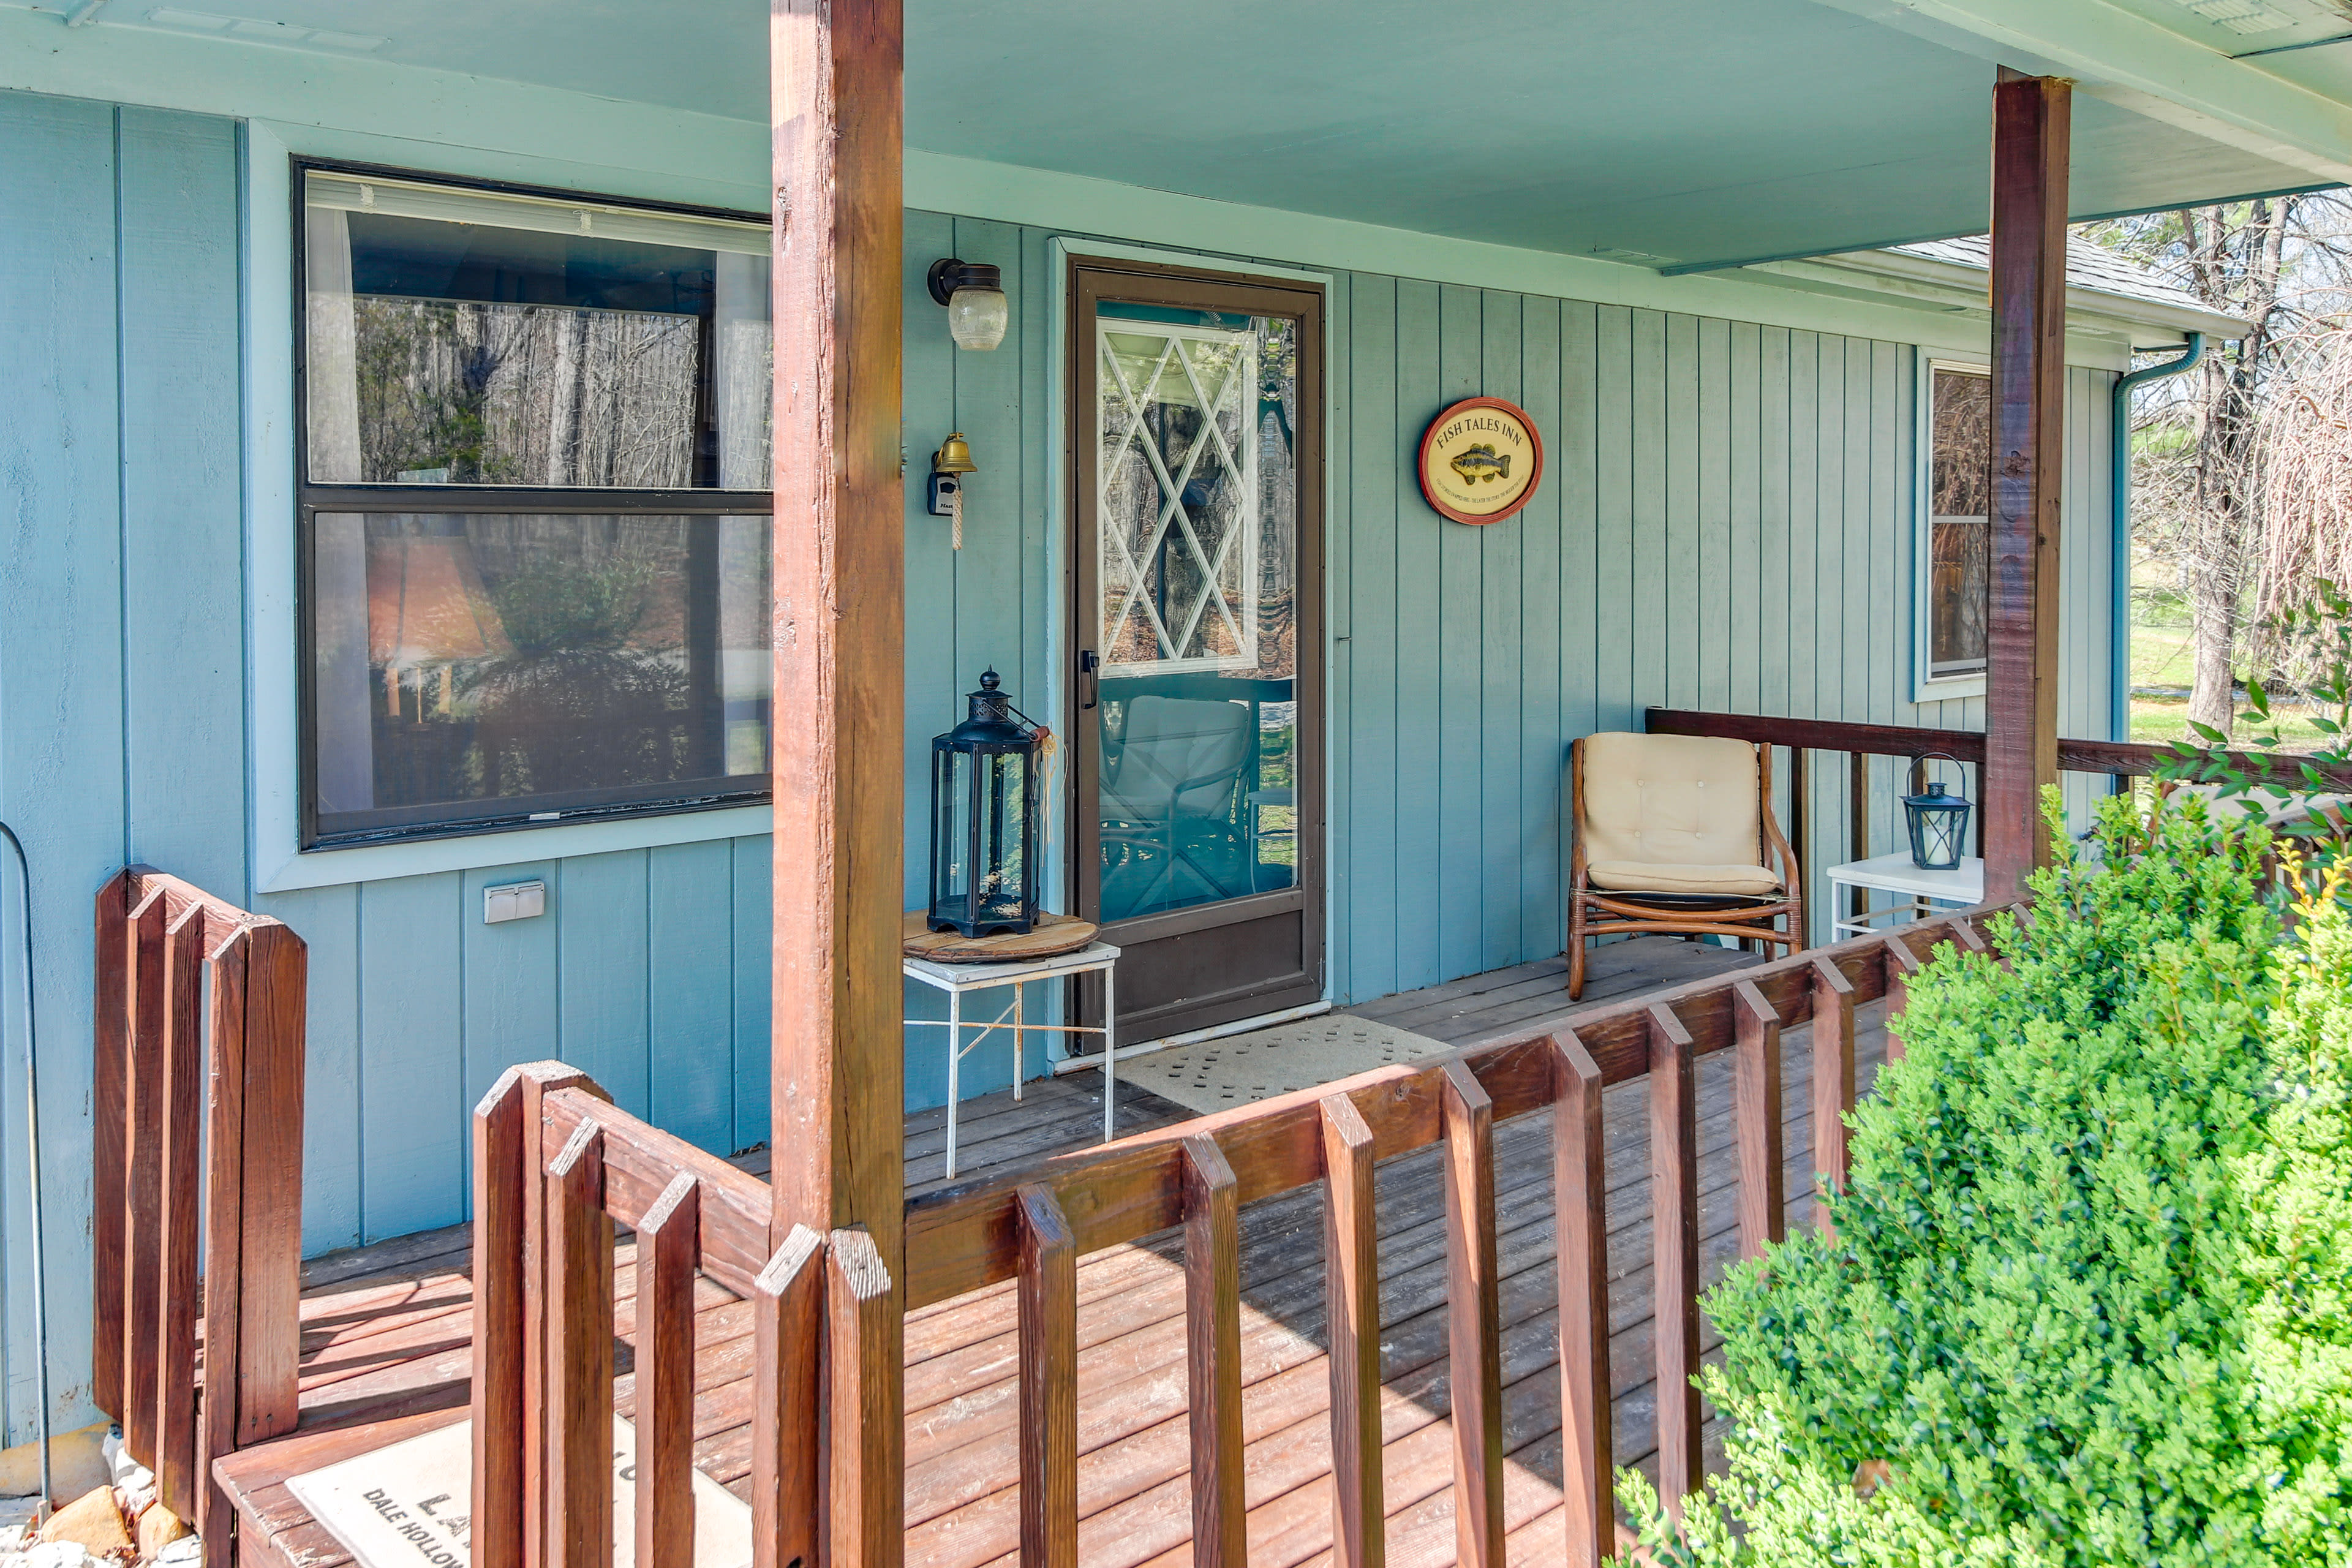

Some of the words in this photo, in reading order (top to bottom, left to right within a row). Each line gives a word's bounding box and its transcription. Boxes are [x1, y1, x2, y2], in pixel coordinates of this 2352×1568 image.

[1436, 422, 1462, 450] FISH
[1465, 418, 1499, 432] TALES
[1502, 423, 1522, 446] INN
[363, 1488, 408, 1523] DALE
